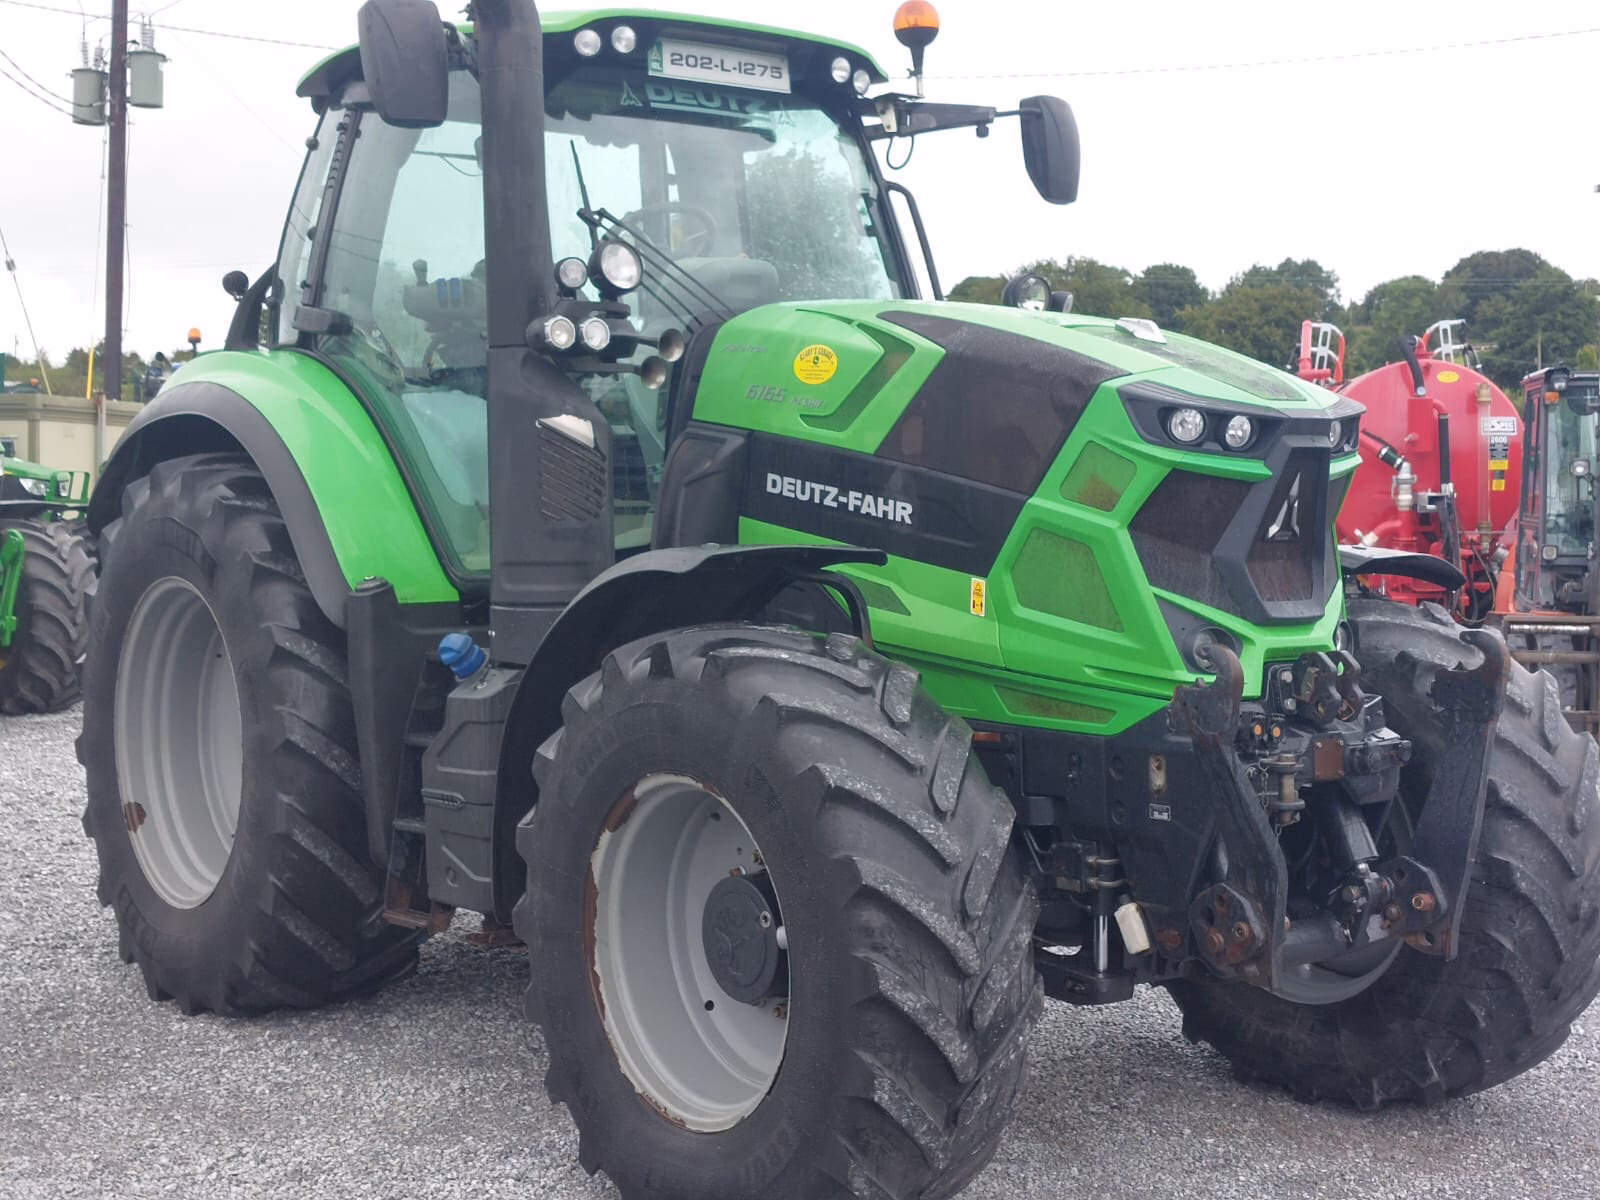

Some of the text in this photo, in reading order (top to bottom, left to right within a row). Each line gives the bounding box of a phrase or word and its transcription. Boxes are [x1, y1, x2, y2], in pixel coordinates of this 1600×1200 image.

[670, 52, 783, 80] 202-L-1275
[645, 84, 769, 114] DEUTZ
[744, 384, 785, 403] 6165
[766, 472, 913, 525] DEUTZ-FAHR
